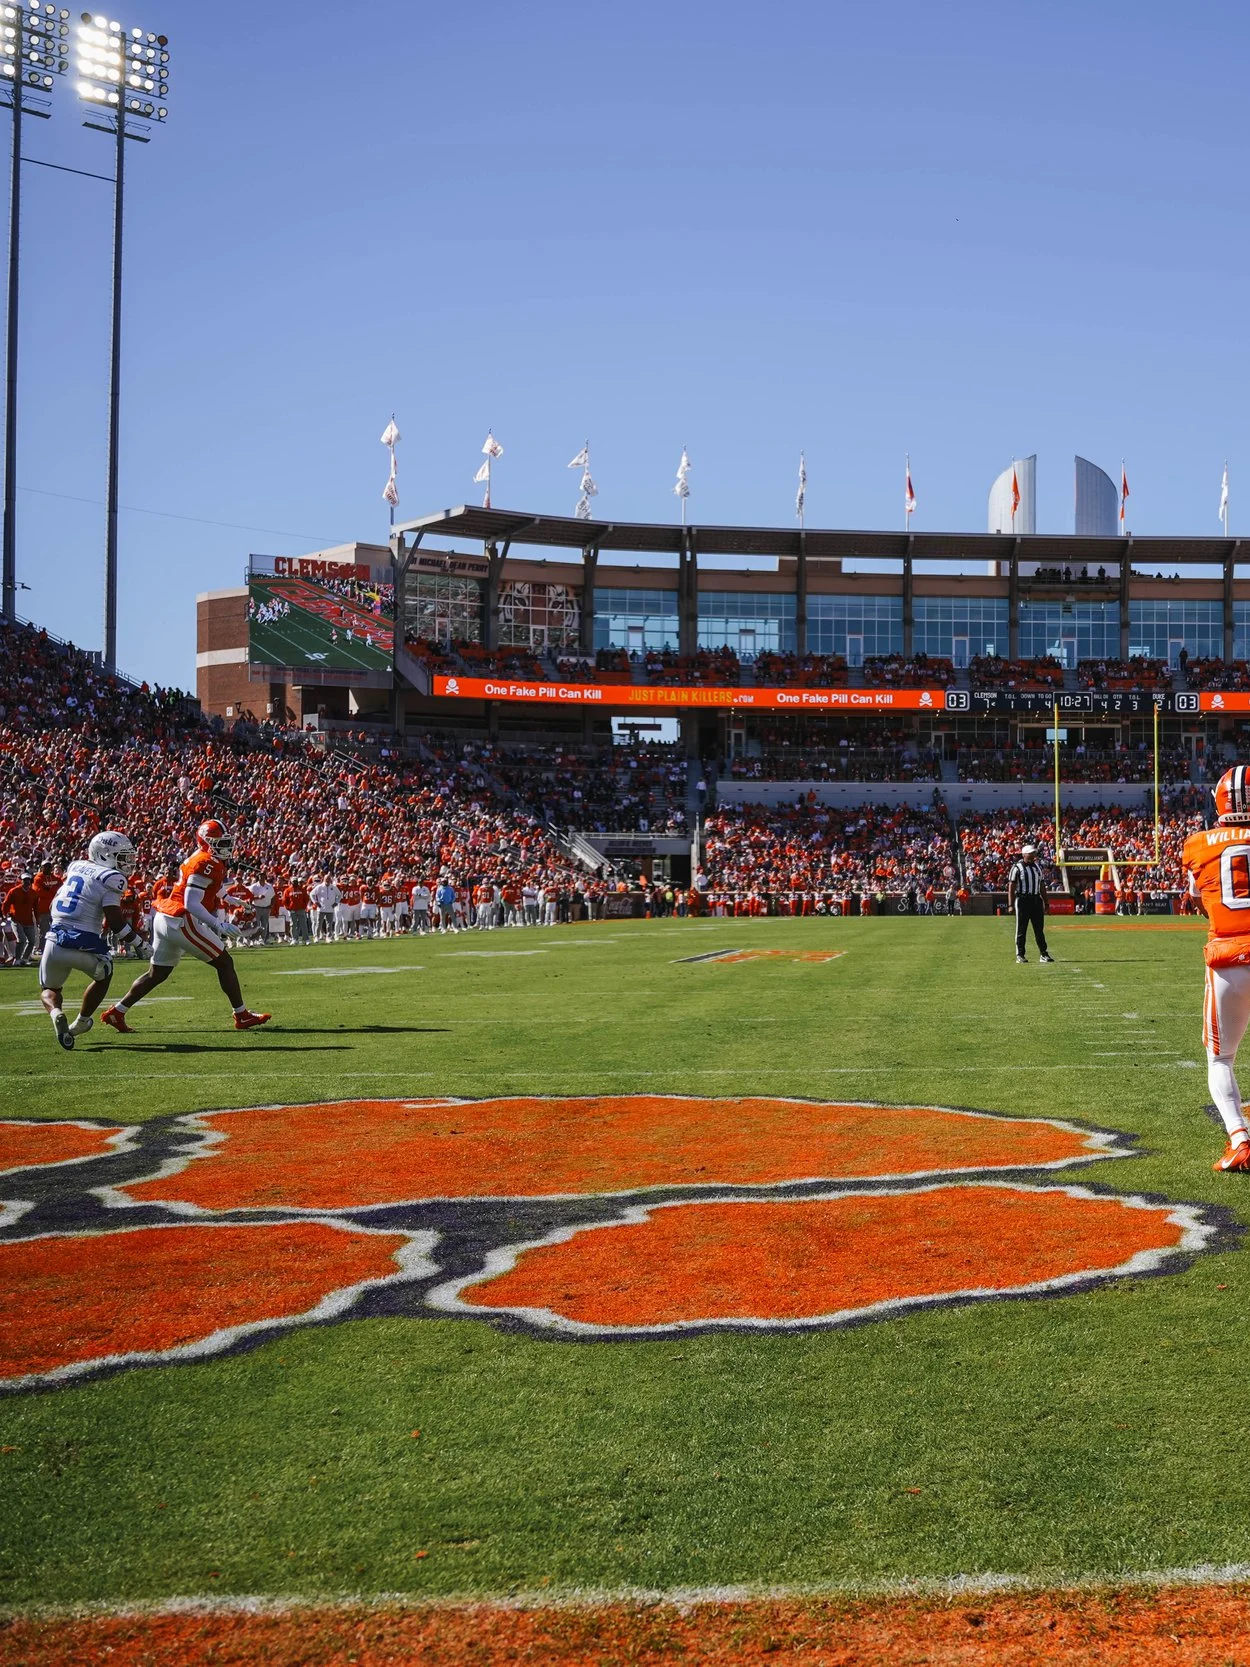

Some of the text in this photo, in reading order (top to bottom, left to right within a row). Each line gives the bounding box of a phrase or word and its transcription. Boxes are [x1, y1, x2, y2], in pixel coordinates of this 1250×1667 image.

[274, 556, 371, 581] CLEMSON
[484, 684, 602, 700] One Fake Pill Can Kill
[628, 690, 655, 701] JUST
[657, 690, 688, 702] PLAIN
[776, 693, 893, 704] One Fake Pill Can Kill
[948, 694, 966, 708] 03
[1060, 696, 1090, 707] 10:27
[1179, 696, 1197, 709] 03
[1045, 700, 1051, 709] 4
[1101, 701, 1108, 709] 4
[1115, 701, 1121, 710] 2
[1132, 701, 1138, 710] 3
[203, 863, 214, 875] 5
[117, 879, 125, 890] 3
[56, 875, 85, 913] 3
[382, 895, 392, 904] 36
